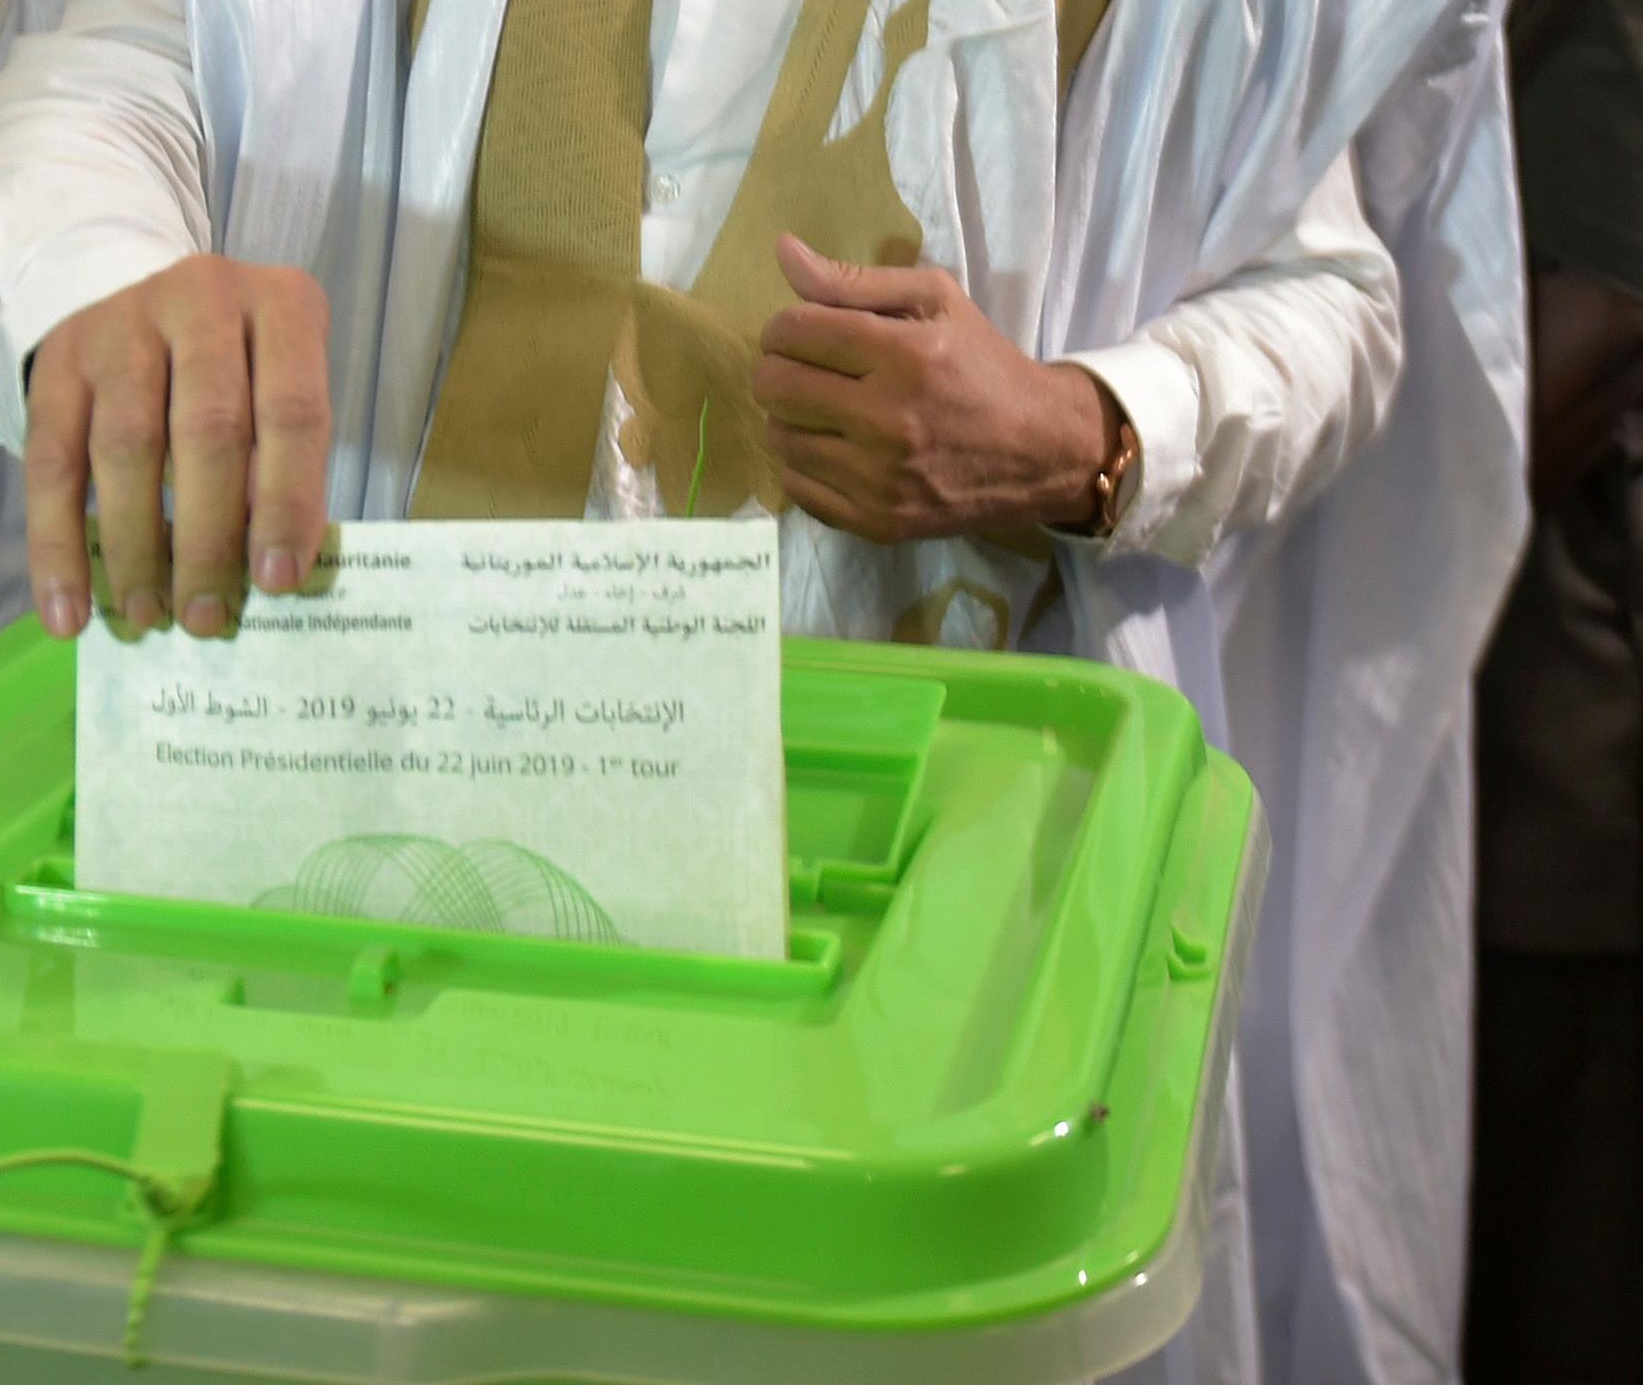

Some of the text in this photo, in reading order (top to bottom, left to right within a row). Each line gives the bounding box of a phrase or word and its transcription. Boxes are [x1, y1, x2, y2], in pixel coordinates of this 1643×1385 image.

[460, 550, 770, 580] الجمهورية الإسلامية الموريتانية
[307, 611, 412, 635] Indépendante
[564, 614, 635, 635] المستقلة
[642, 614, 705, 640] الوطنية
[711, 614, 766, 634] اللجنة
[150, 681, 196, 717] الأول
[204, 689, 268, 724] الشوط
[295, 695, 355, 720] 2019
[429, 695, 455, 720] 22
[483, 696, 565, 731] الرئاسية
[574, 696, 685, 734] الإنتخابات
[156, 740, 234, 769] Election
[240, 744, 394, 774] Présidentielle
[400, 748, 431, 774] du
[436, 751, 464, 775] 22
[469, 752, 512, 782] juin
[518, 752, 576, 778] 2019
[630, 756, 681, 779] tour
